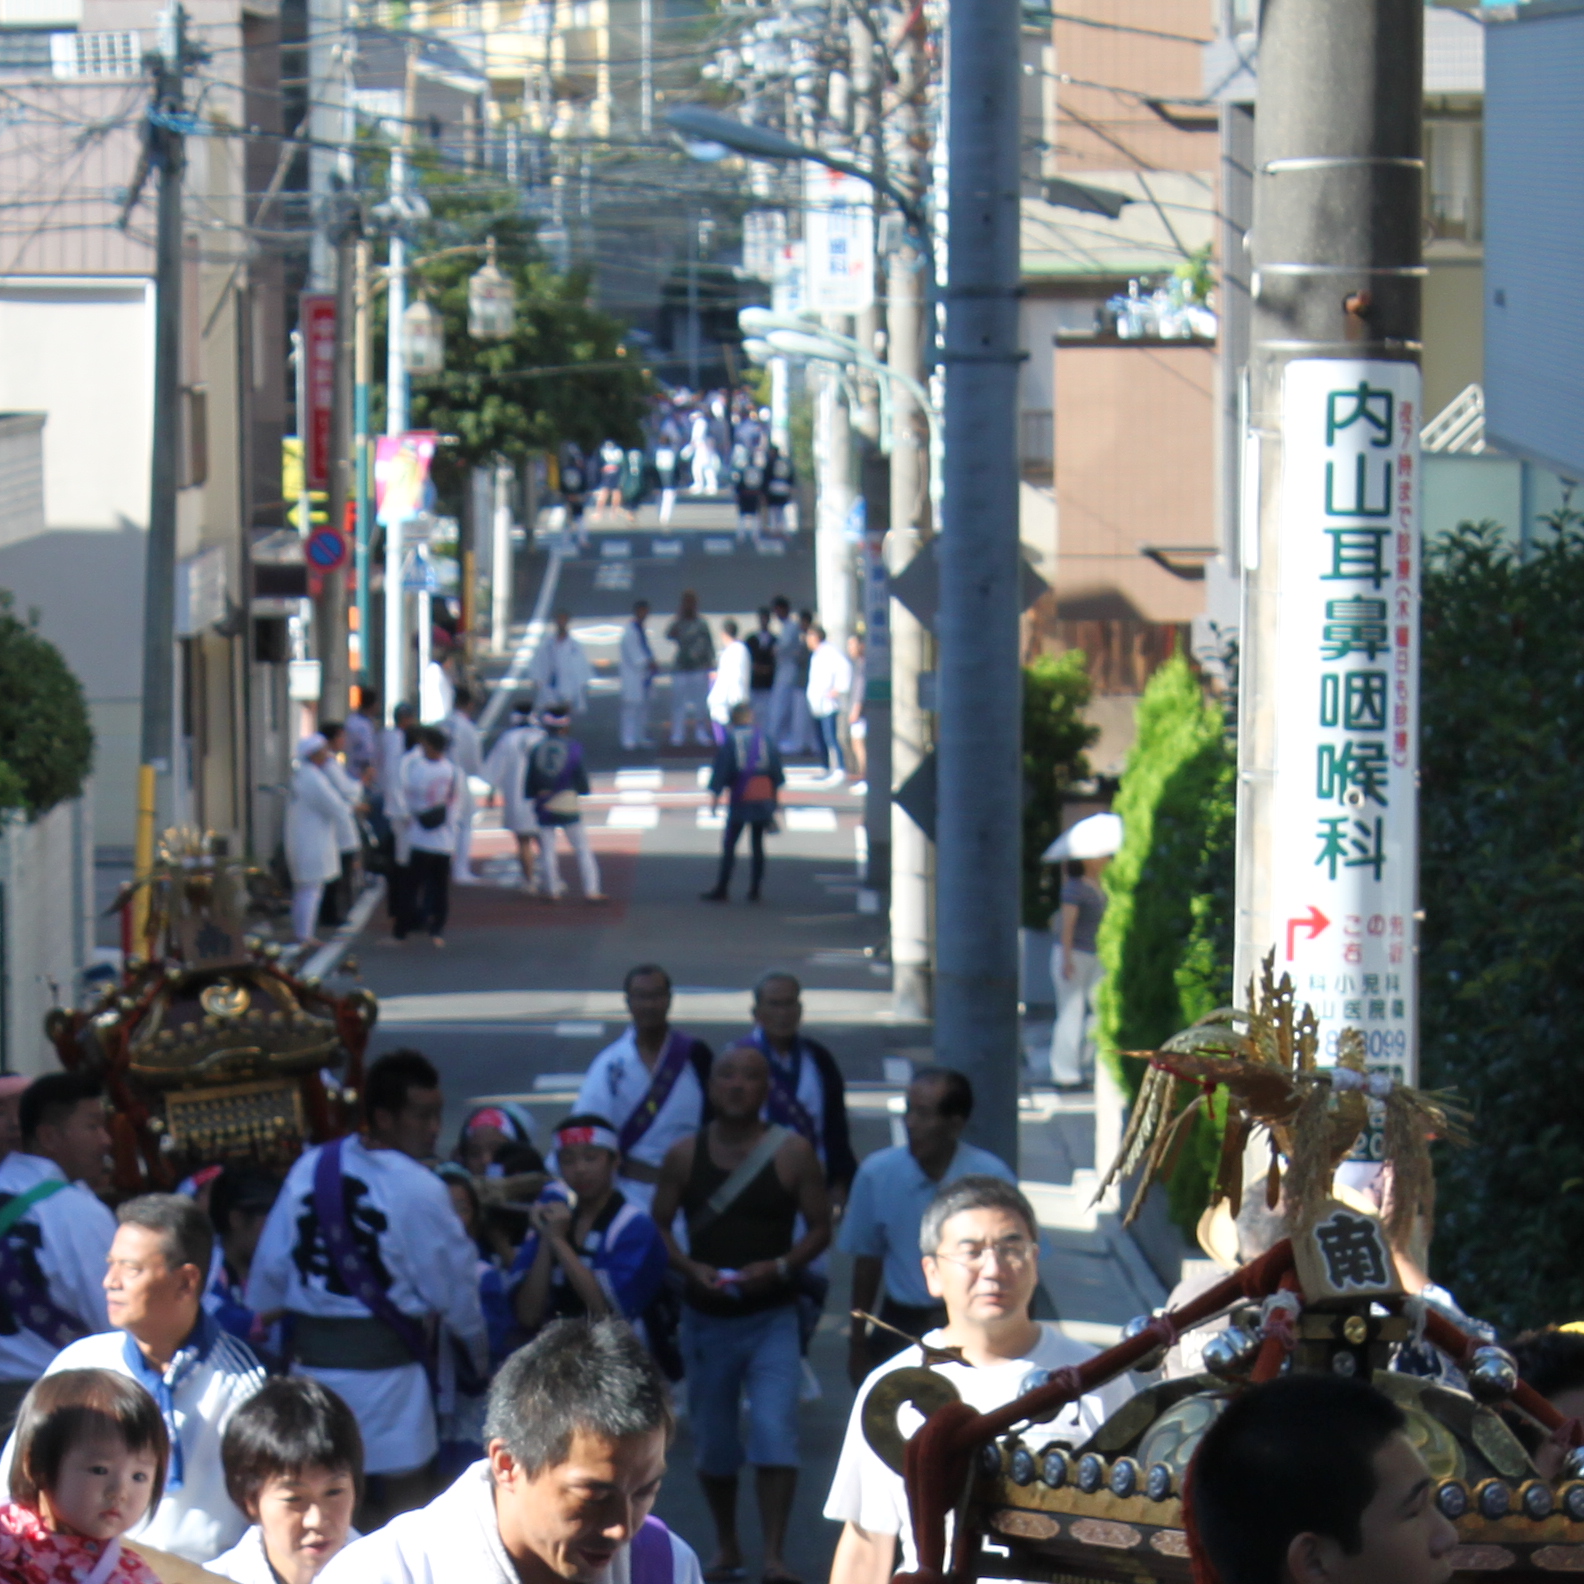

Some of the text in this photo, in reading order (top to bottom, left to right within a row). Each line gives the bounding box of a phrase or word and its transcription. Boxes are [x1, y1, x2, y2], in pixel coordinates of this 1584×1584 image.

[1314, 381, 1393, 881] 内山耳鼻咽喉科
[1317, 1214, 1387, 1289] 南
